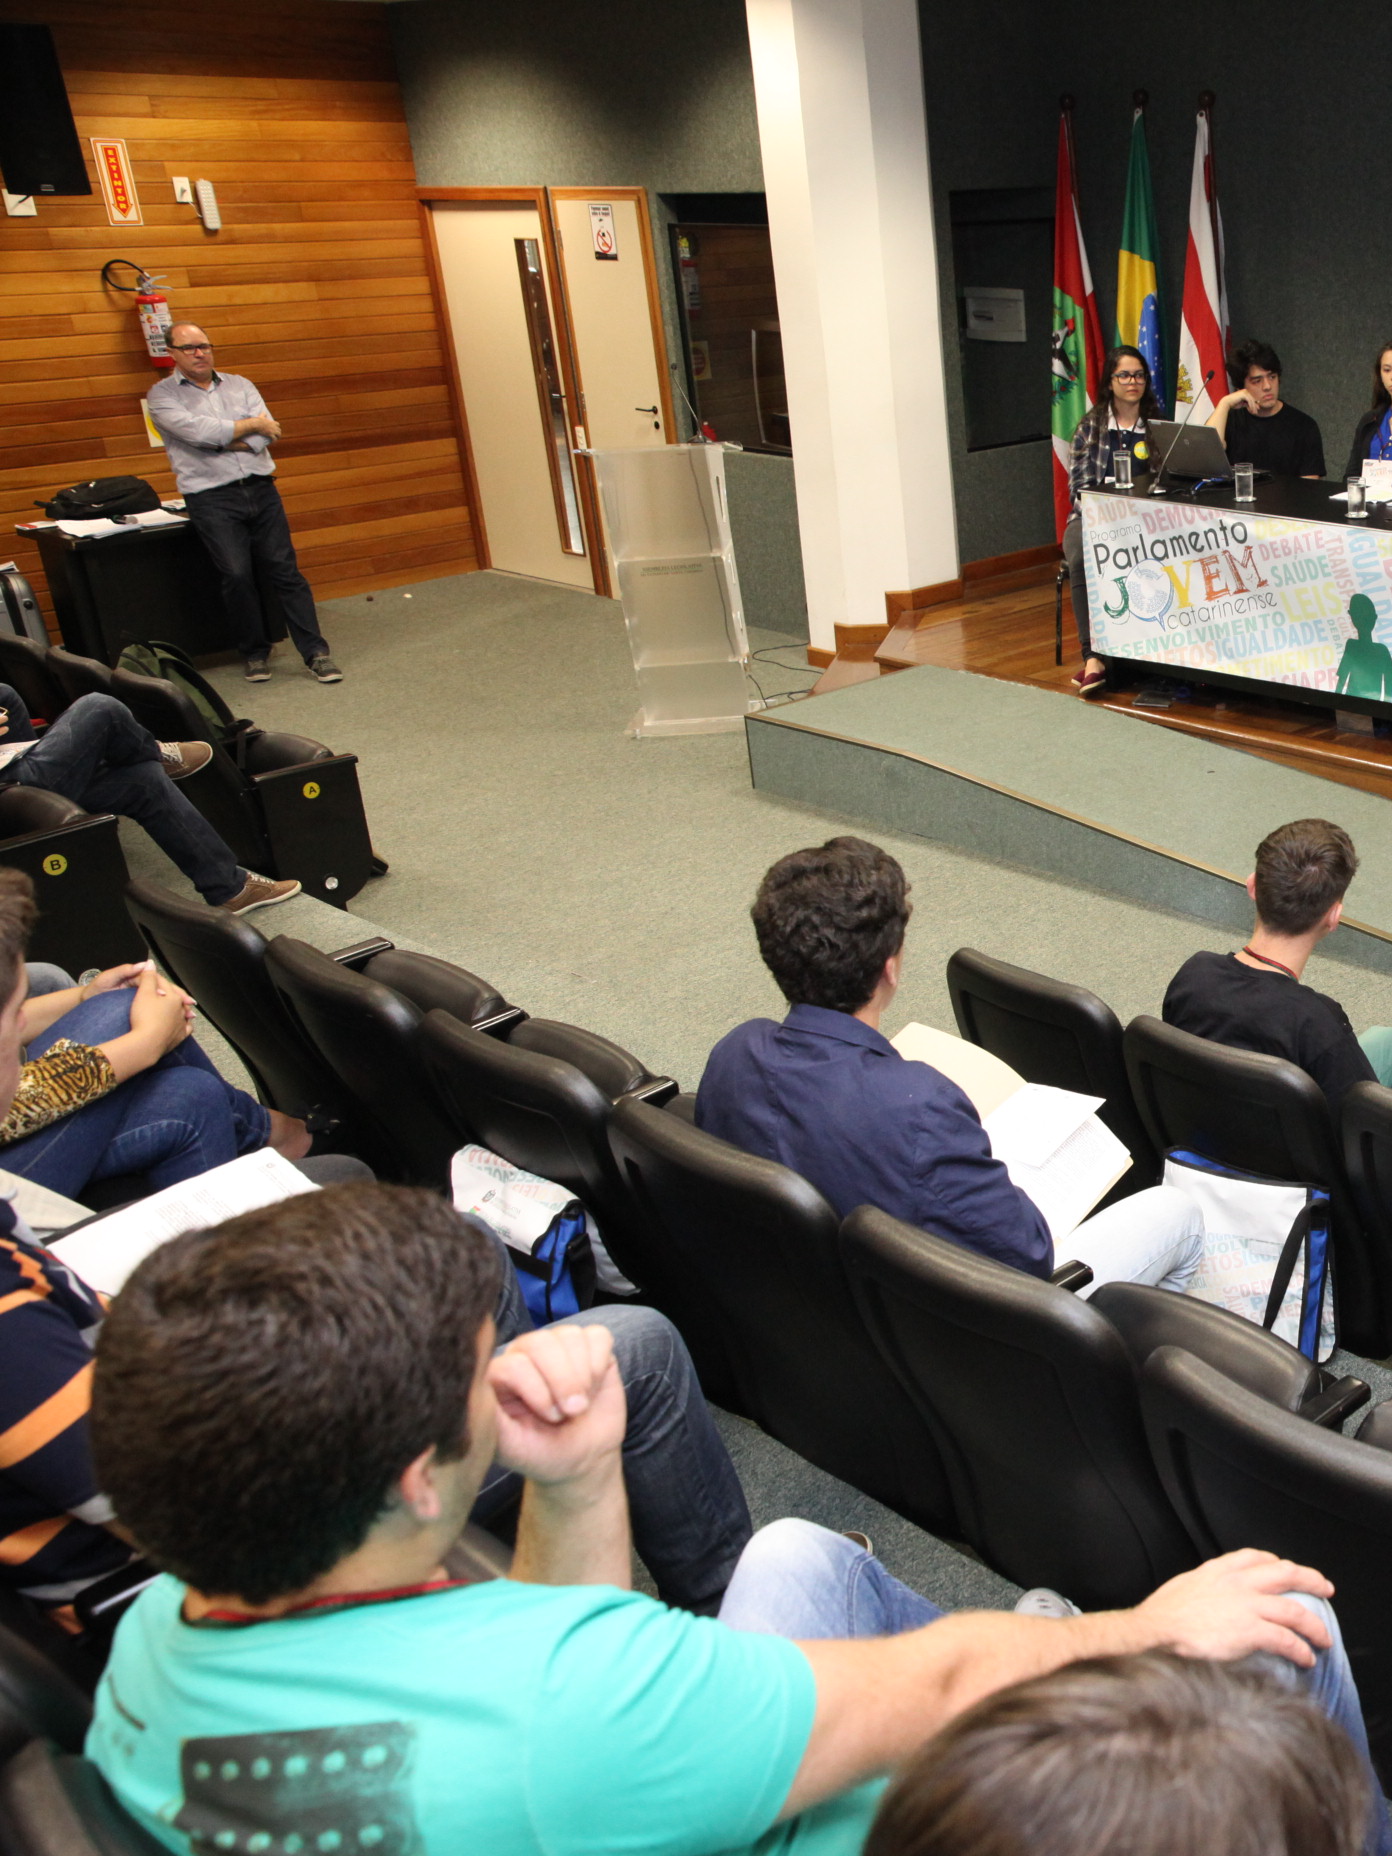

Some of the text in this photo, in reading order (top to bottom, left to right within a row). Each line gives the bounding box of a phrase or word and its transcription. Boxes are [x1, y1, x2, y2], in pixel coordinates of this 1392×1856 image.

[106, 149, 128, 211] EXTINTOR
[1089, 523, 1142, 545] Programa
[1093, 519, 1248, 575] Parlamento
[1258, 530, 1326, 562] DEBATE
[1103, 546, 1269, 624] JOVEM
[1279, 580, 1343, 623] LEIS
[1166, 592, 1277, 630] catarinense
[1216, 618, 1330, 662] IGUALDADE
[308, 786, 317, 795] A
[49, 859, 62, 871] B
